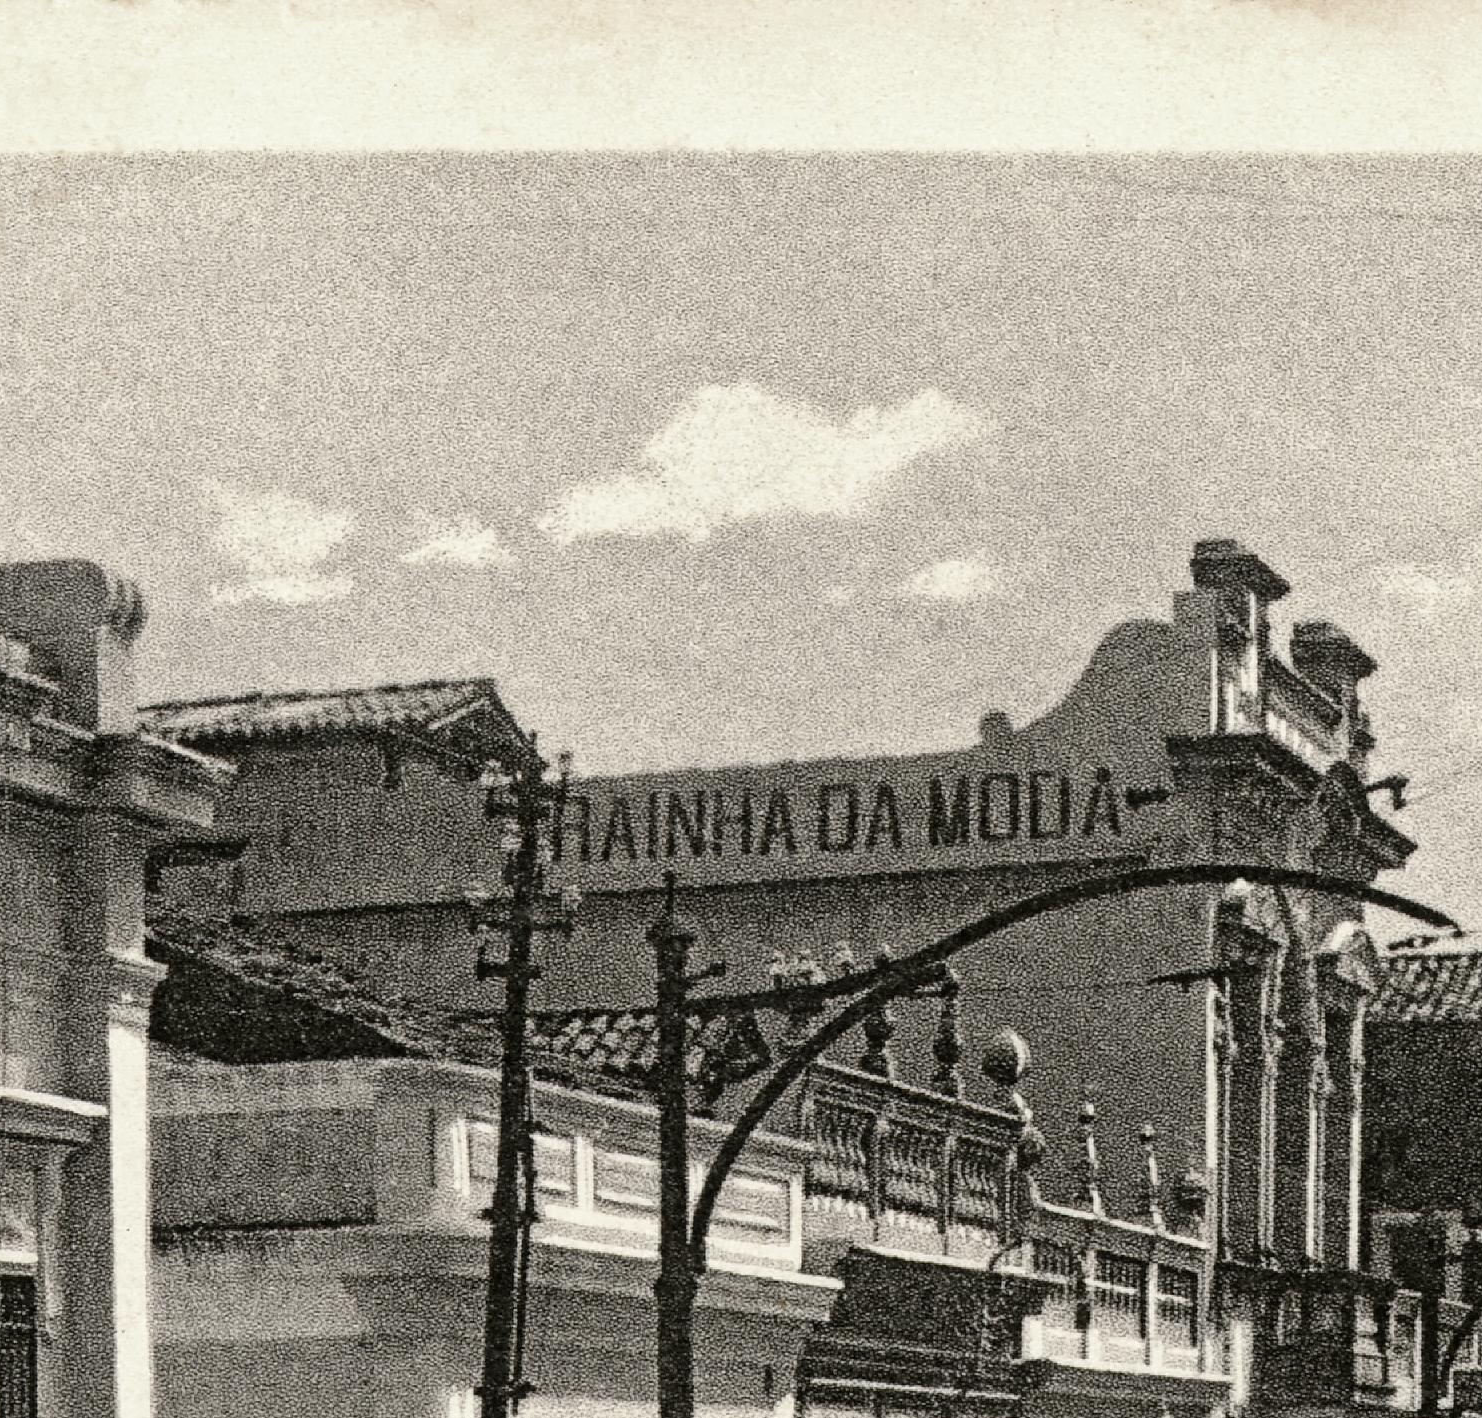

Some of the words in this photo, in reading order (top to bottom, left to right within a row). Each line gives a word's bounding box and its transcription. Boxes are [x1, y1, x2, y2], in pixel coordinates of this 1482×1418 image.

[553, 786, 797, 863] RAINHA
[817, 782, 903, 853] DA
[928, 770, 1122, 849] MODA
